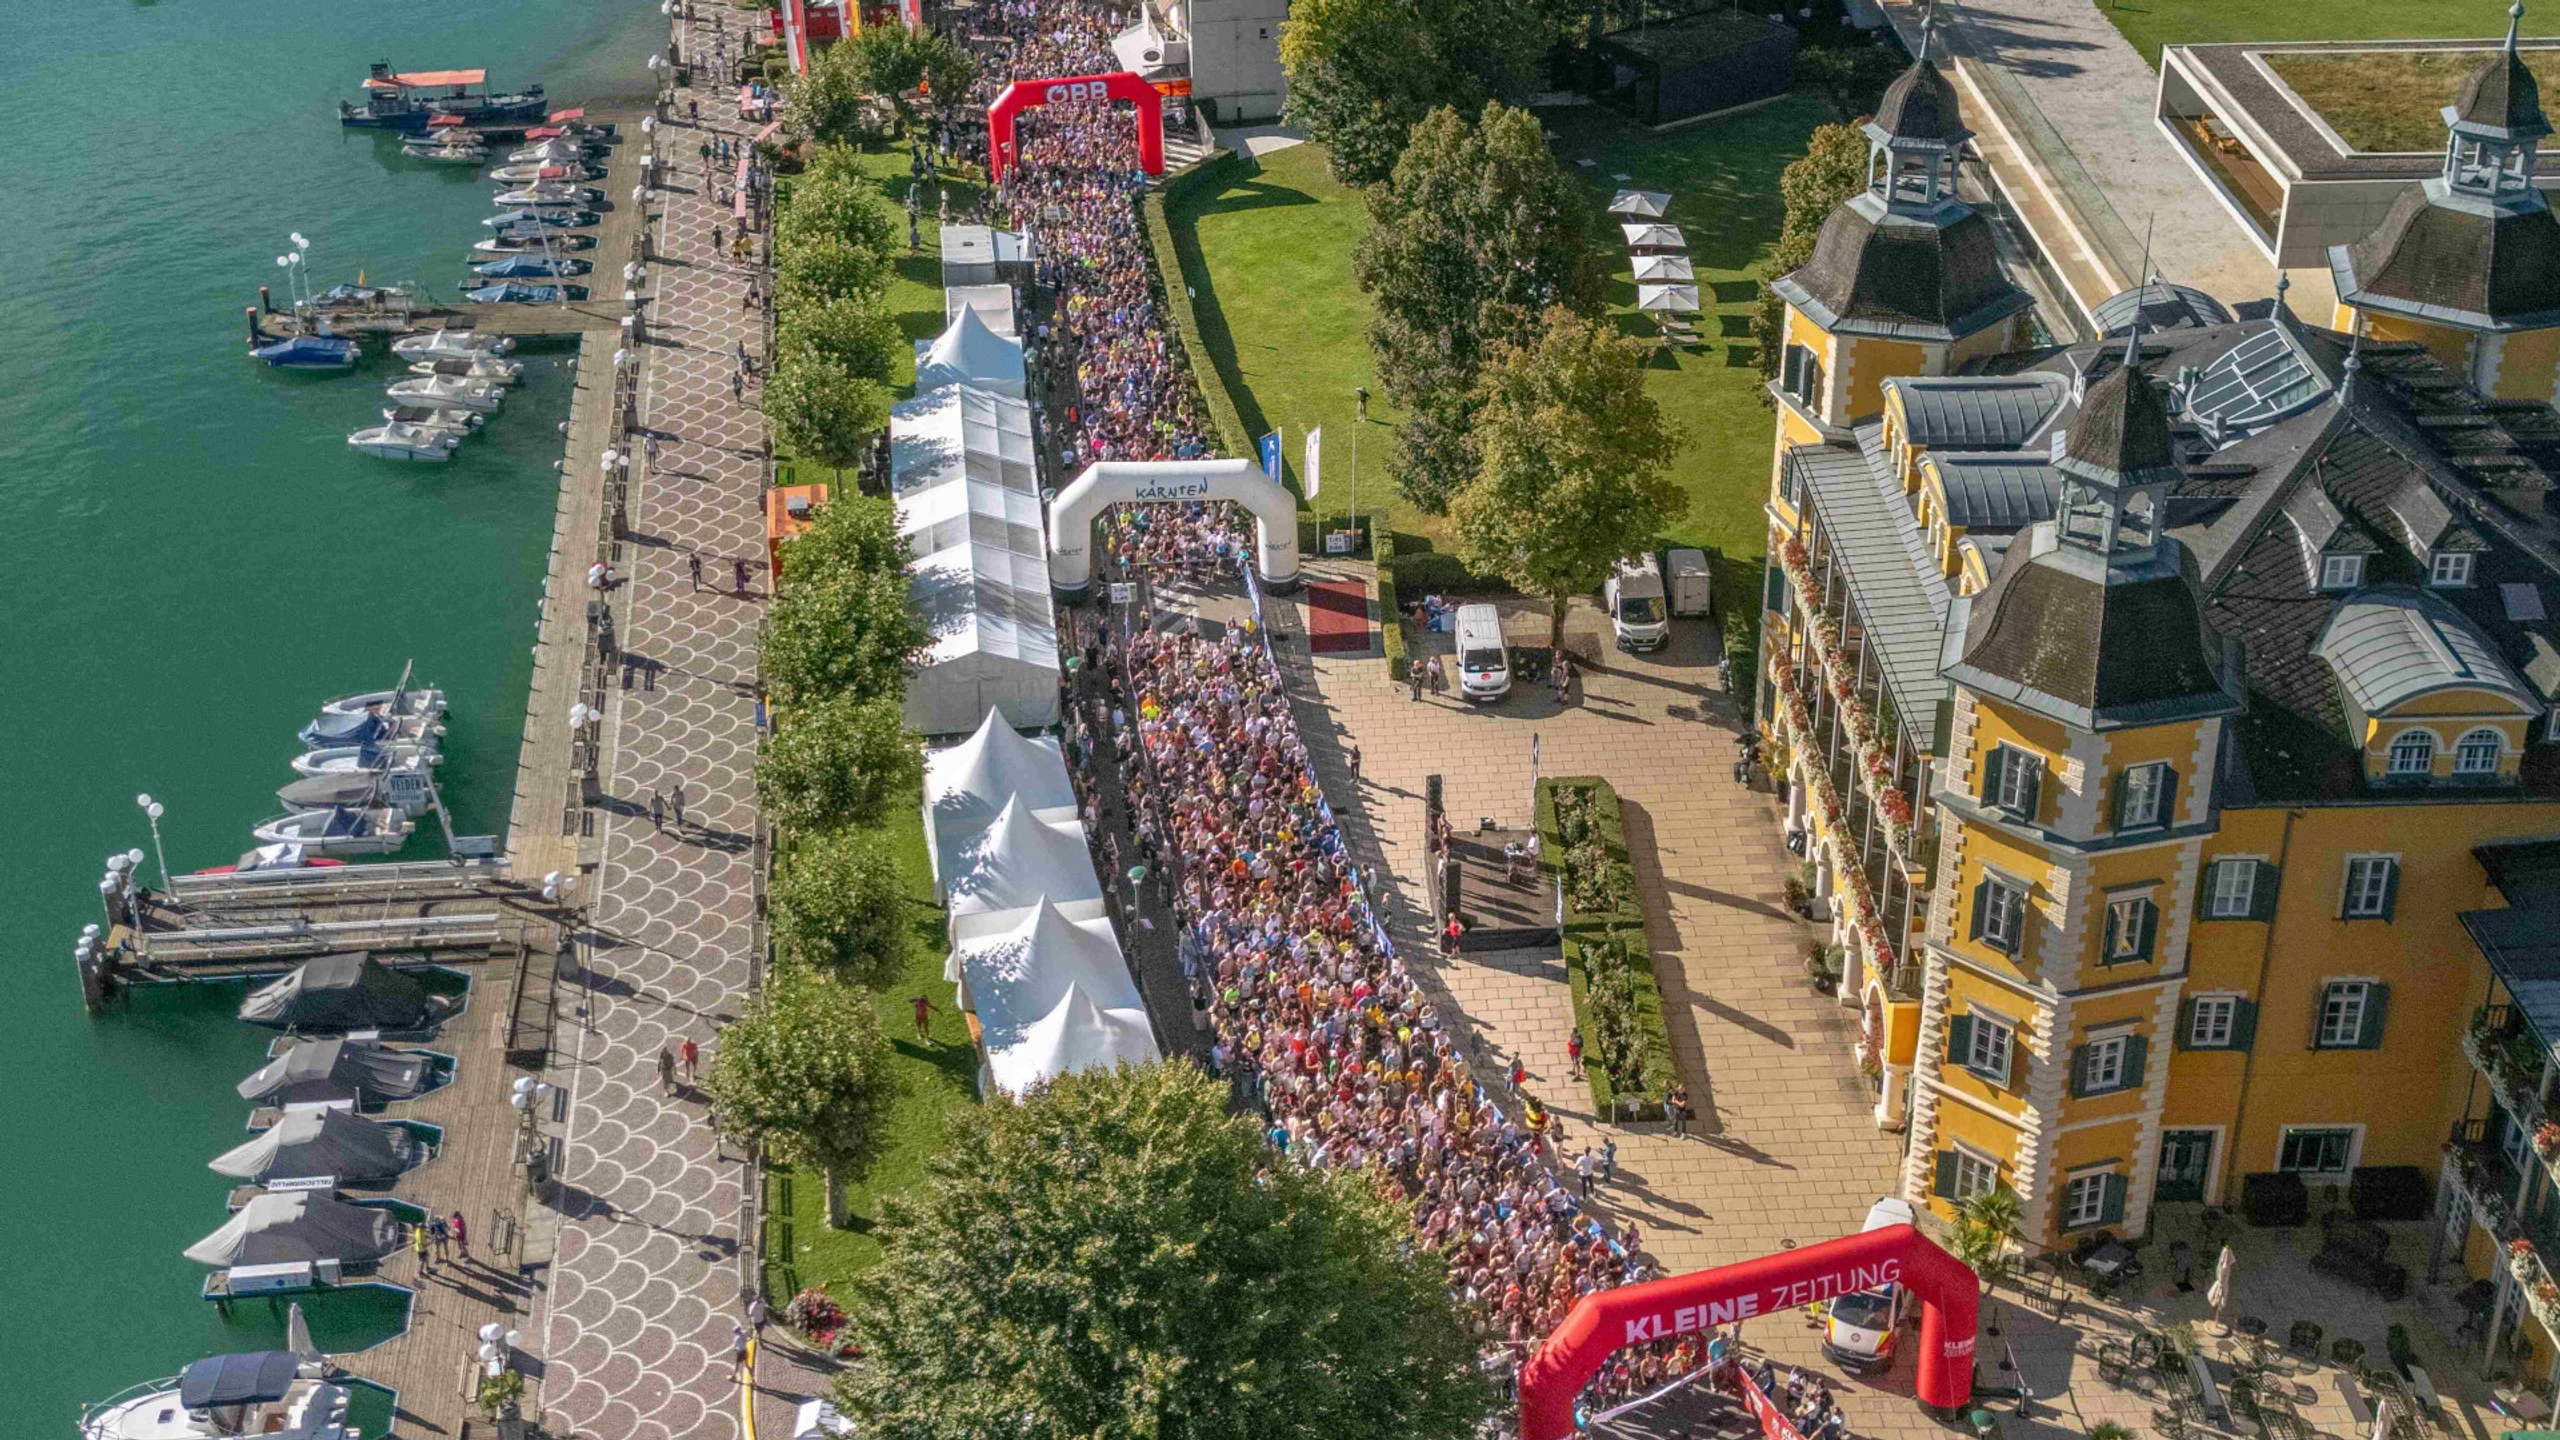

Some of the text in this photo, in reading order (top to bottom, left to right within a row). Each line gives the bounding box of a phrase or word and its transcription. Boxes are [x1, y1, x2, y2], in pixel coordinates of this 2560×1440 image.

[1047, 81, 1107, 104] ÖBB
[1136, 476, 1208, 499] KÄRNTEN
[391, 778, 421, 791] VELDEN
[1626, 1258, 1900, 1343] KLEINE ZEITUNG
